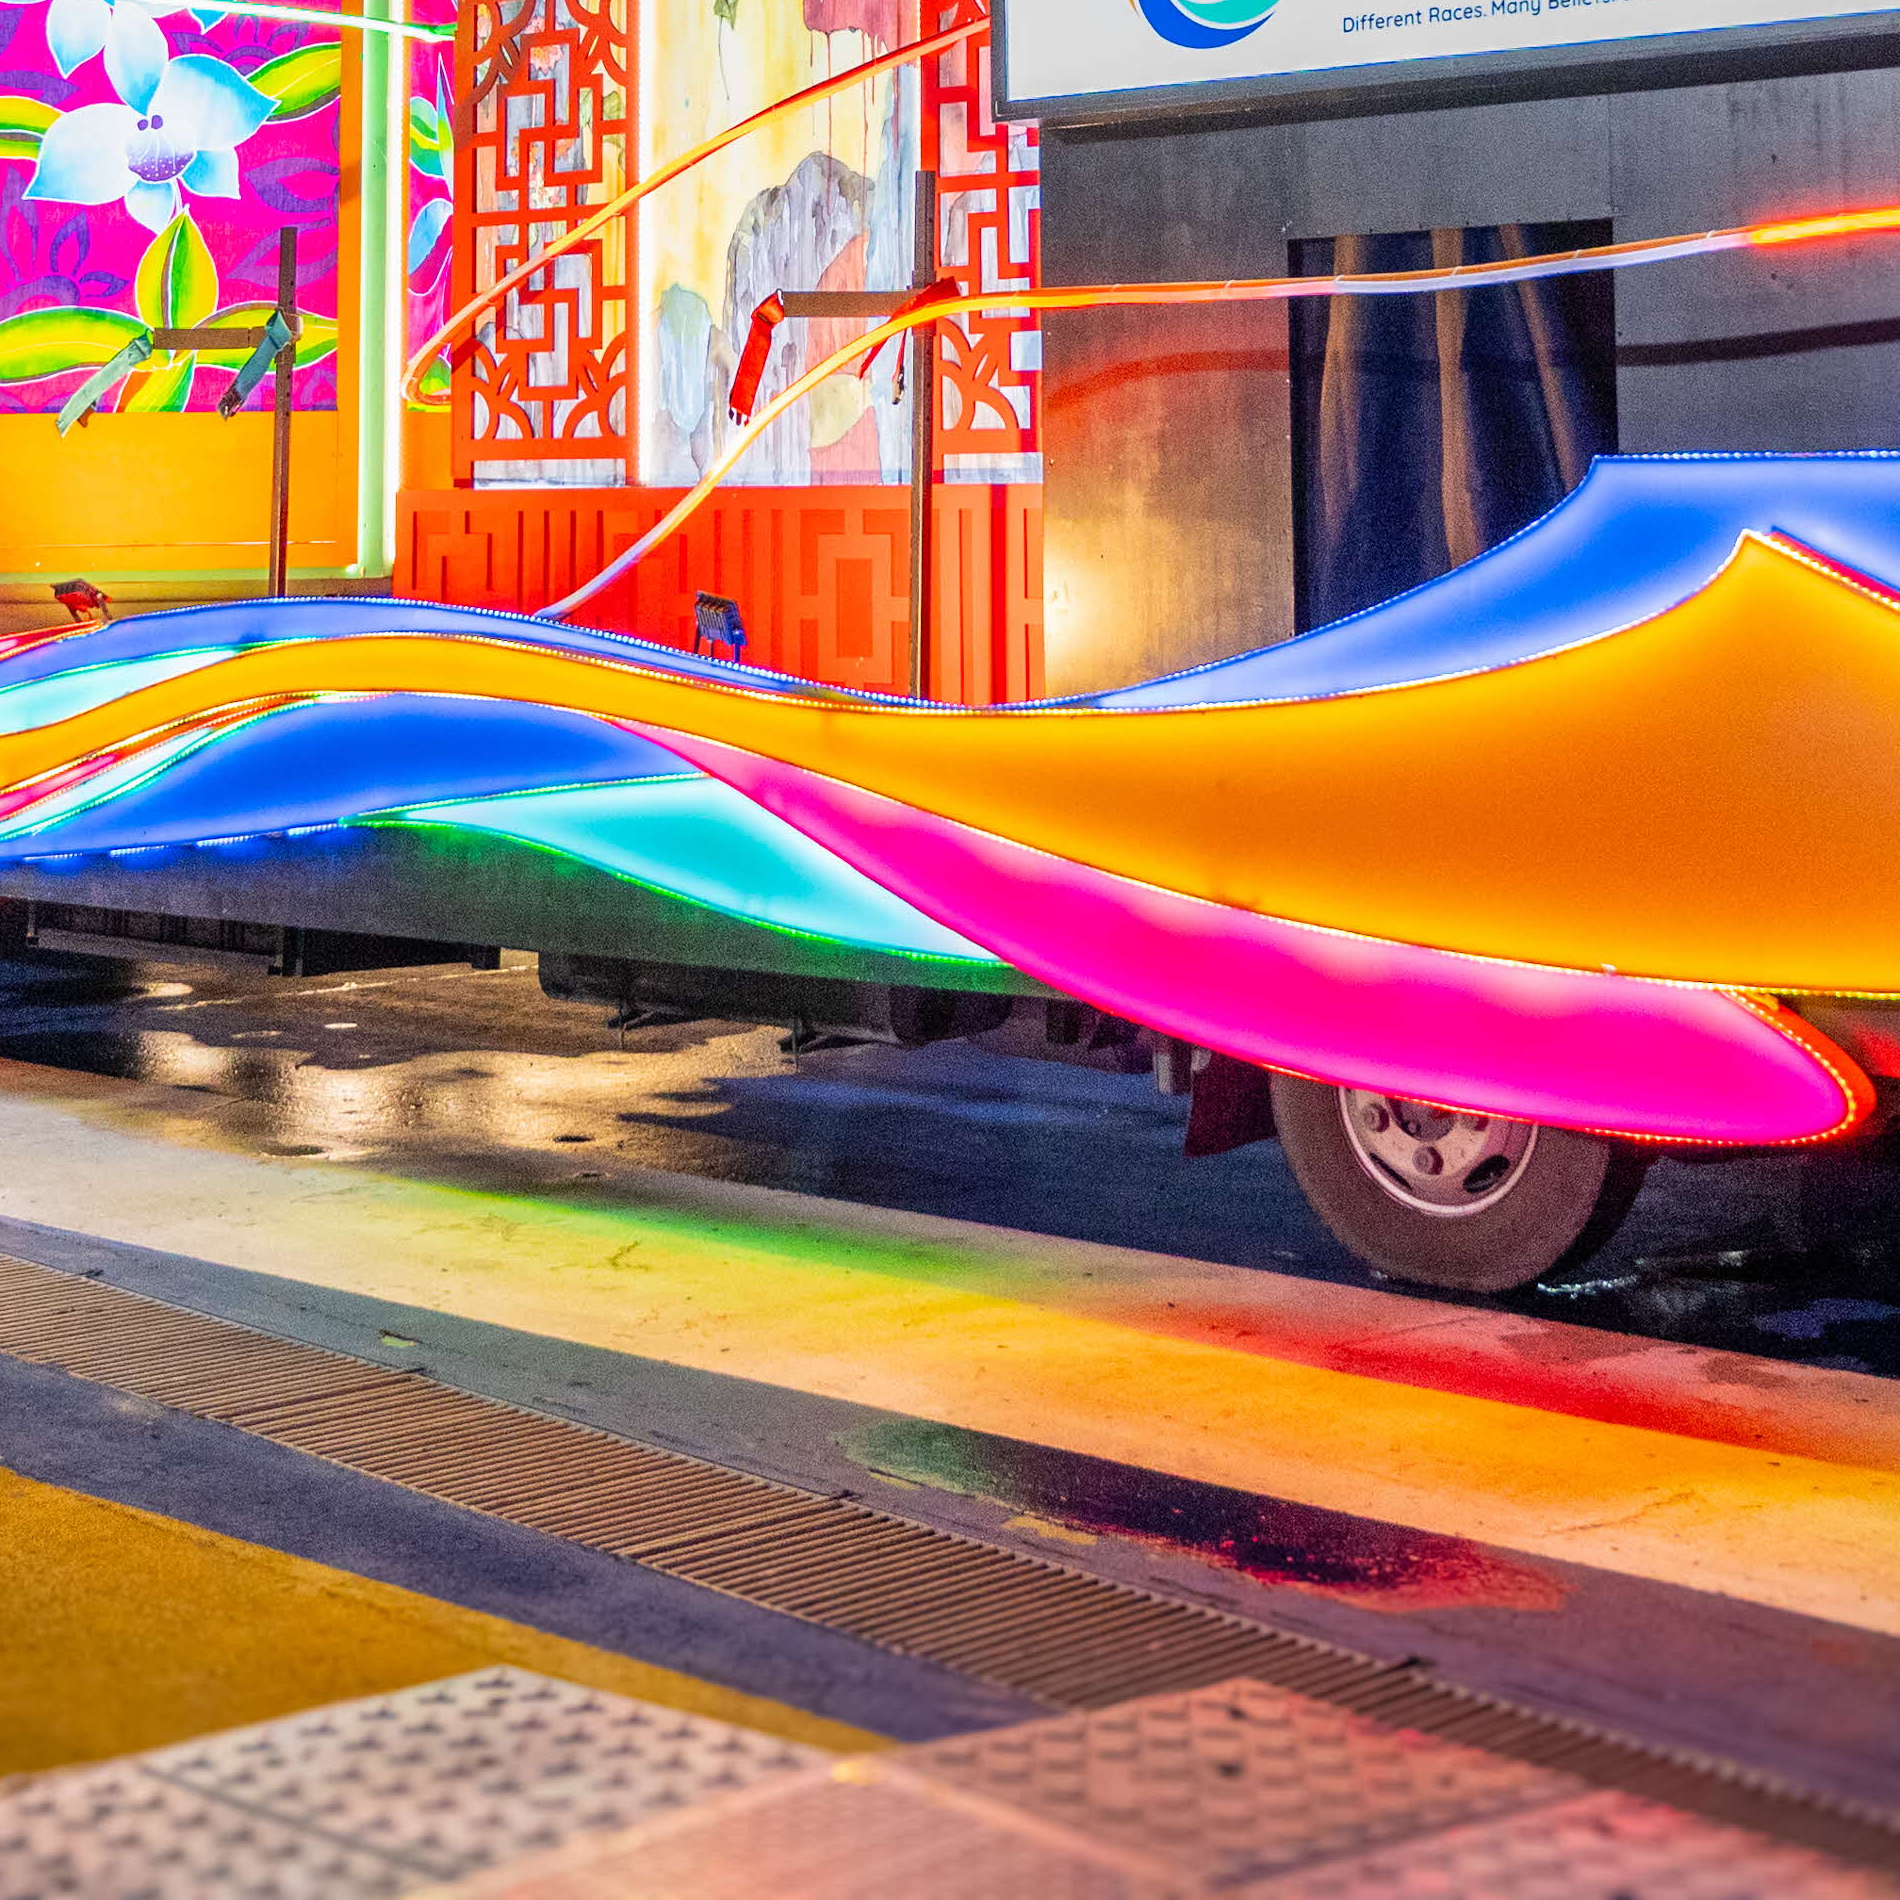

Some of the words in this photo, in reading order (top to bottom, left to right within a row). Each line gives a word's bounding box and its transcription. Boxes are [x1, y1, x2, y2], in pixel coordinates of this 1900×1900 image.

[1342, 10, 1423, 34] Different
[1428, 4, 1488, 24] Races.
[1491, 0, 1541, 16] Many
